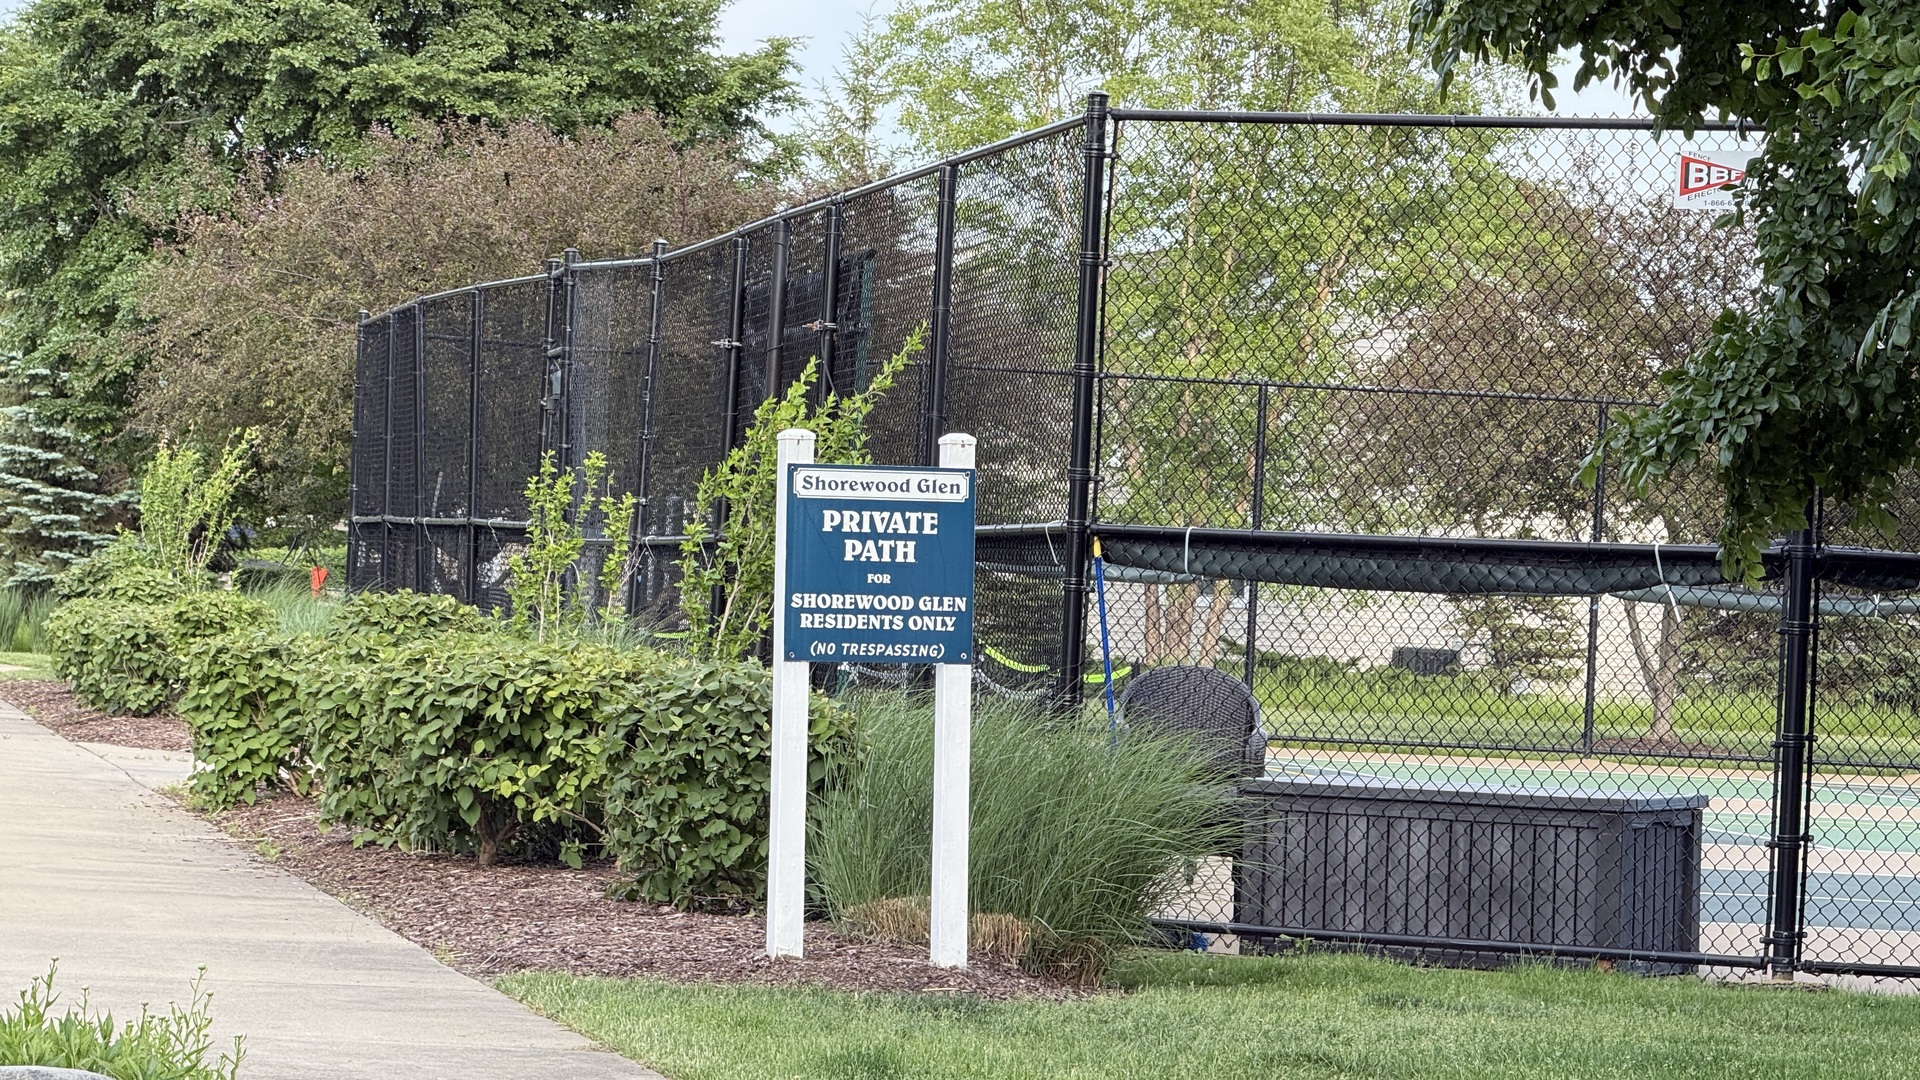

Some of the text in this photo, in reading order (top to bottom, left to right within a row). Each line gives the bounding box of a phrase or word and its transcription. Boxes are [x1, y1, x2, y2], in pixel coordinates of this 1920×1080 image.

[1688, 151, 1711, 161] FENCE
[1688, 162, 1742, 189] BBF
[802, 475, 961, 494] Shorewood Glen
[822, 510, 938, 534] PRIVATE
[844, 539, 916, 563] PATH
[867, 574, 891, 584] FOR
[791, 593, 967, 612] SHOREWOOD GLEN
[800, 613, 957, 632] RESIDENTS ONLY
[810, 640, 945, 659] (NO TRESPASSING)
